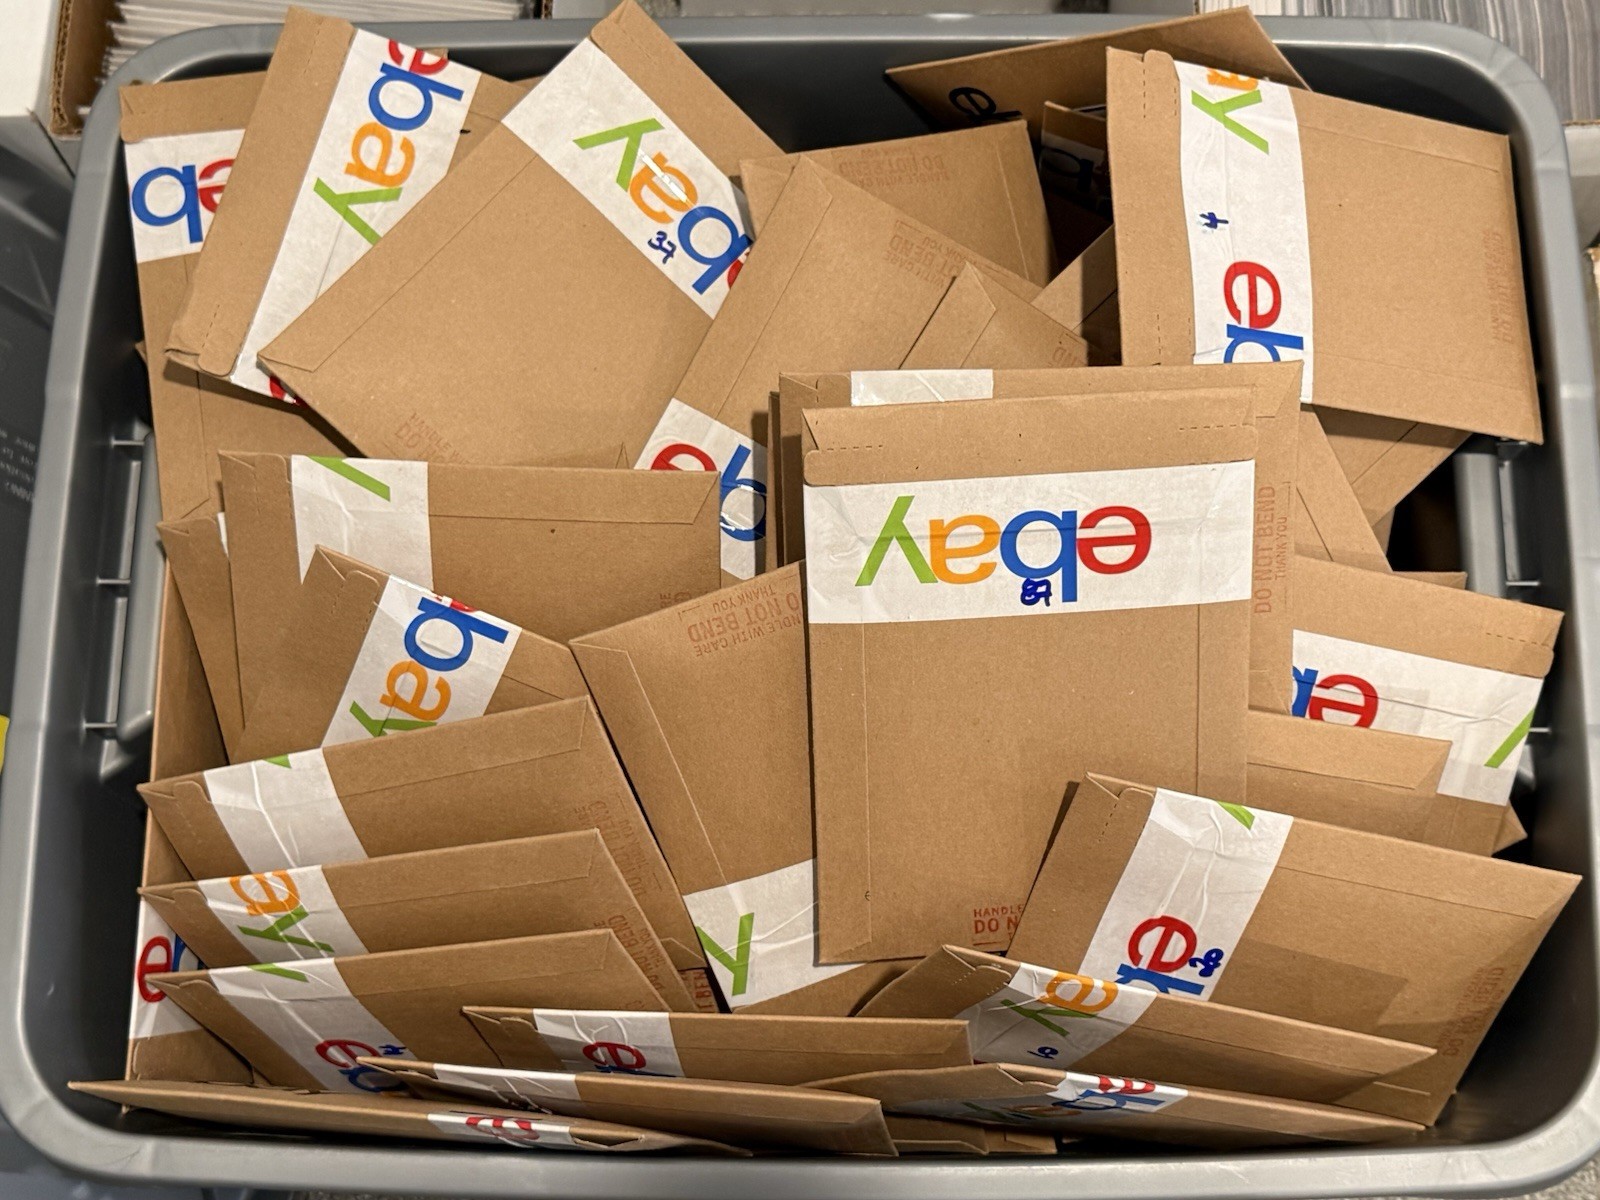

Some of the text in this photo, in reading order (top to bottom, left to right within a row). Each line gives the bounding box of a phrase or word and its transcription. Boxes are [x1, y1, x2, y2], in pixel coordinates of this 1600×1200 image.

[572, 118, 754, 294] bay
[647, 230, 677, 264] 37
[1255, 486, 1275, 537] BEND
[855, 495, 1152, 603] ebay
[711, 583, 776, 613] THANK YOU
[742, 598, 782, 626] NOT
[1254, 588, 1272, 613] DO
[685, 611, 740, 644] BEND
[730, 625, 765, 645] WITH
[693, 636, 729, 657] CARE
[349, 594, 509, 738] bay
[974, 917, 999, 934] DO
